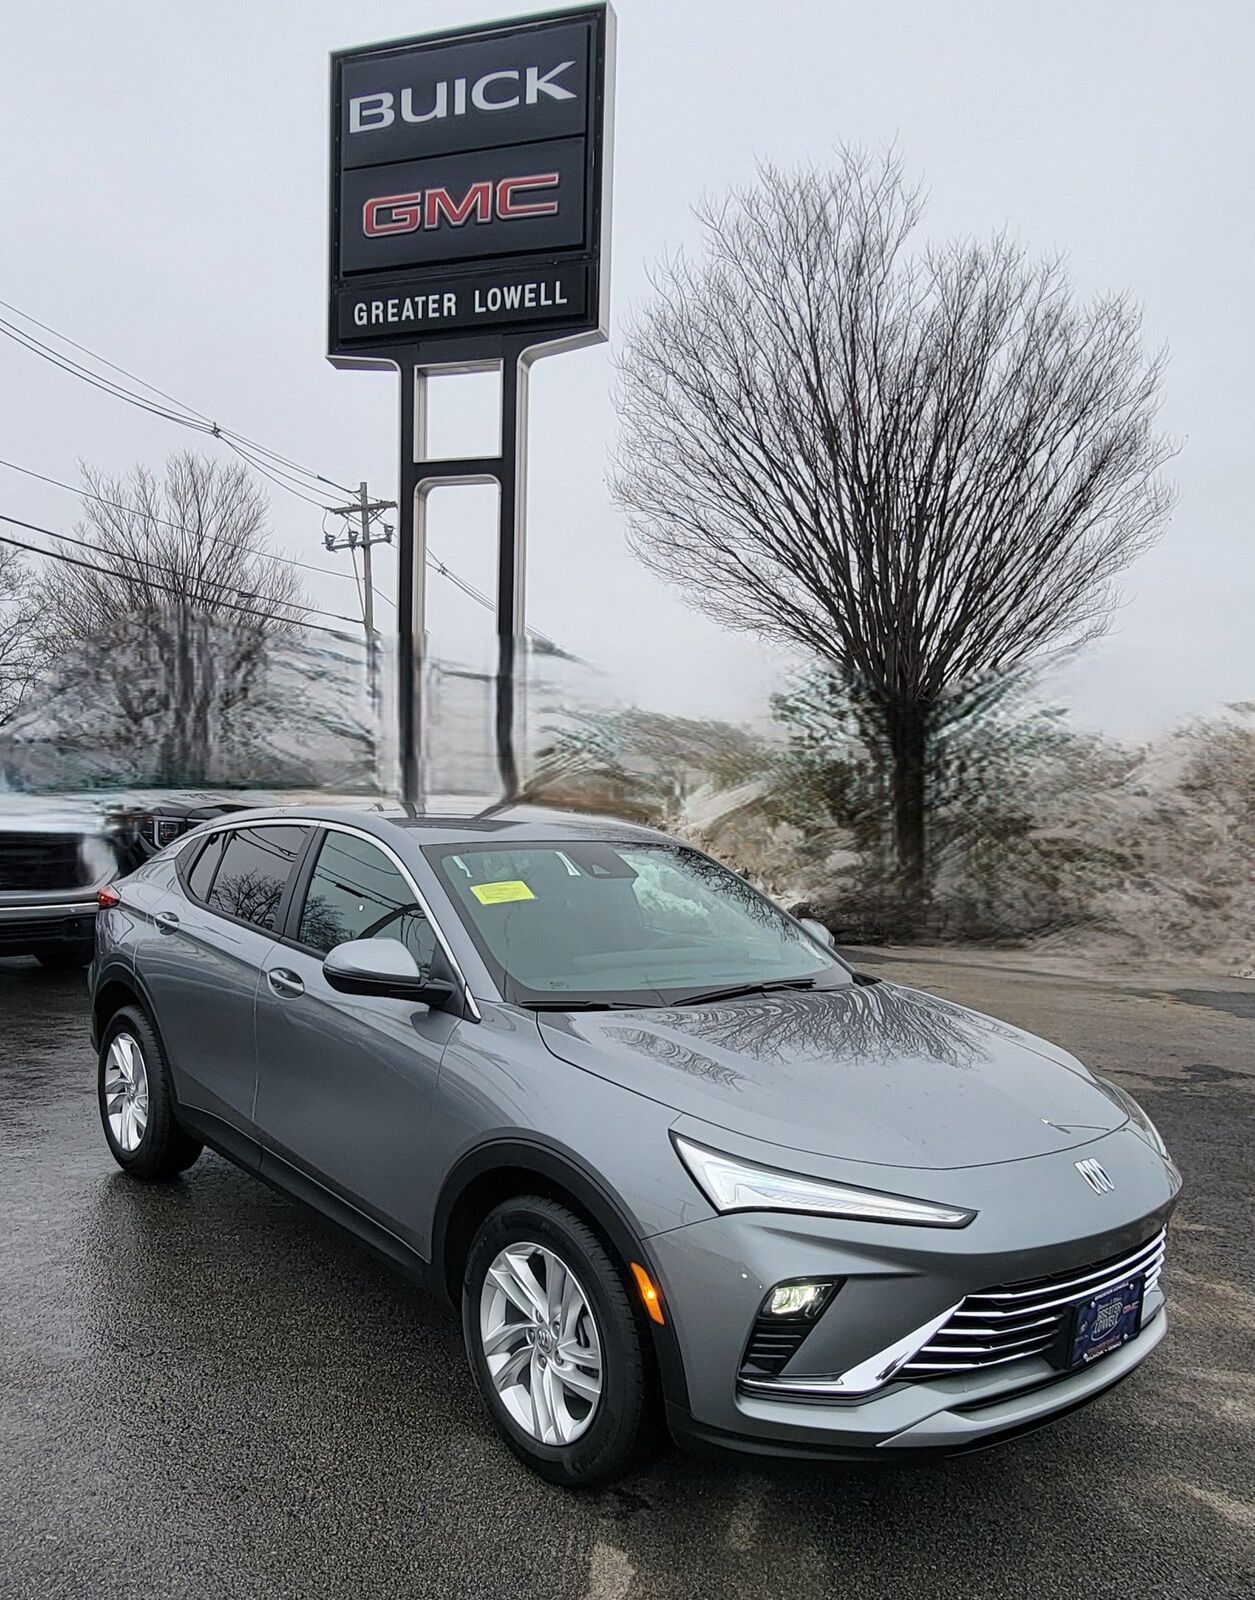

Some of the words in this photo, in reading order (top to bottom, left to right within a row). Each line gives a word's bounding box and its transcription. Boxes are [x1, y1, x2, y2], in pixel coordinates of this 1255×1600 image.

[350, 61, 578, 133] BUICK
[363, 172, 559, 238] GMC
[354, 293, 456, 326] GREATER
[475, 281, 567, 314] LOWELL
